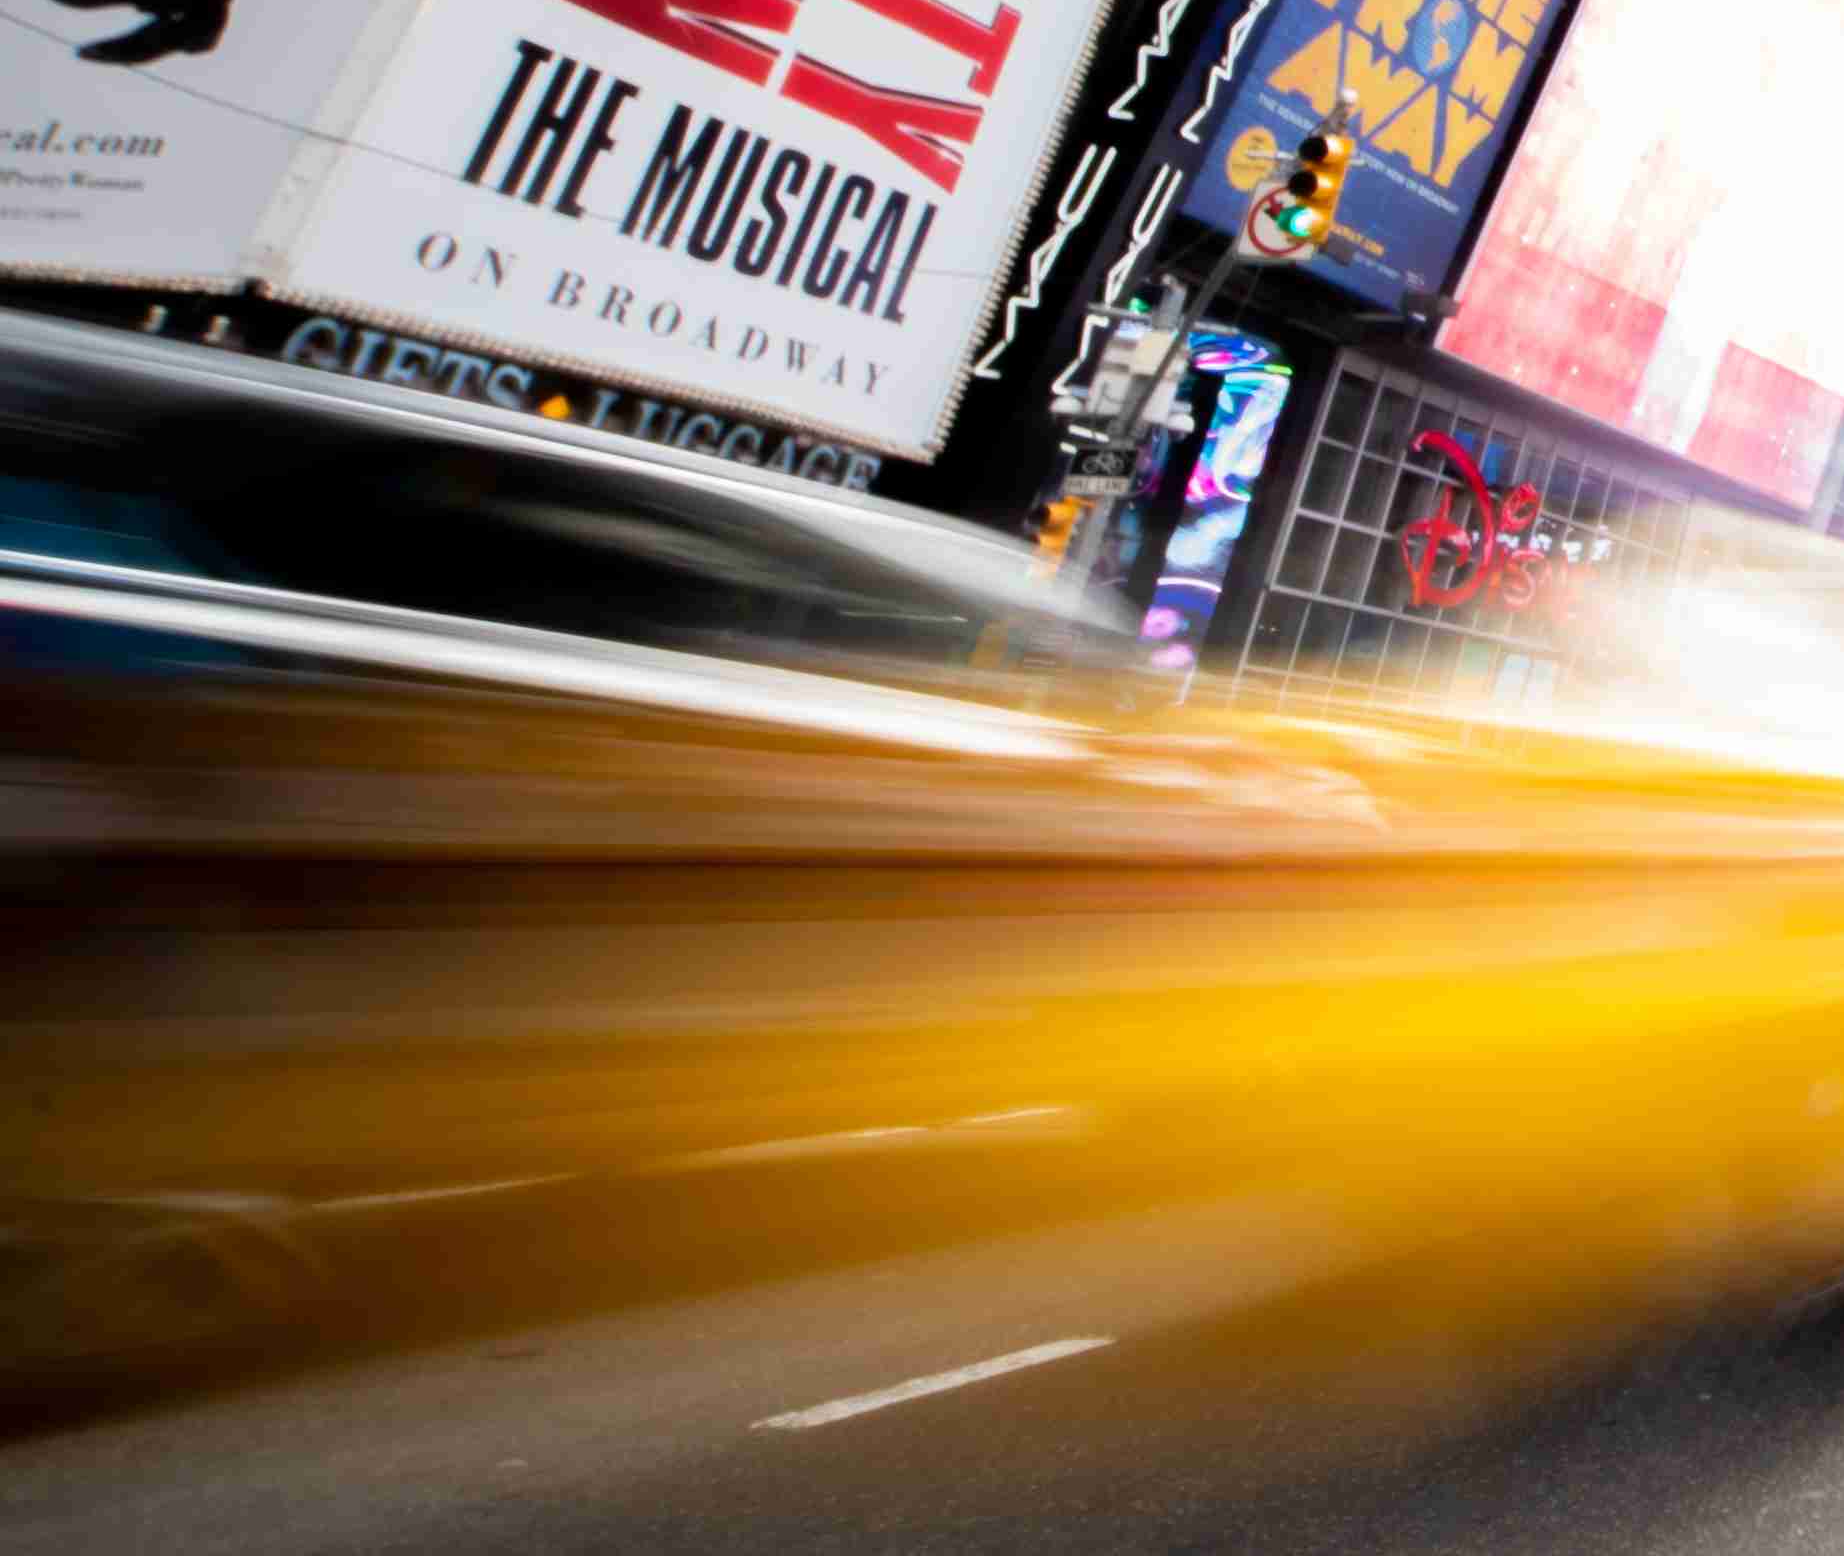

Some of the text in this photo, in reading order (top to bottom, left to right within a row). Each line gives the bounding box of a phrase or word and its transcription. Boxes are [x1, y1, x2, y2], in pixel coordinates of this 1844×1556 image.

[460, 39, 942, 327] THE MUSICAL
[1267, 21, 1495, 190] AWAY
[416, 230, 897, 400] ON BROADWAY
